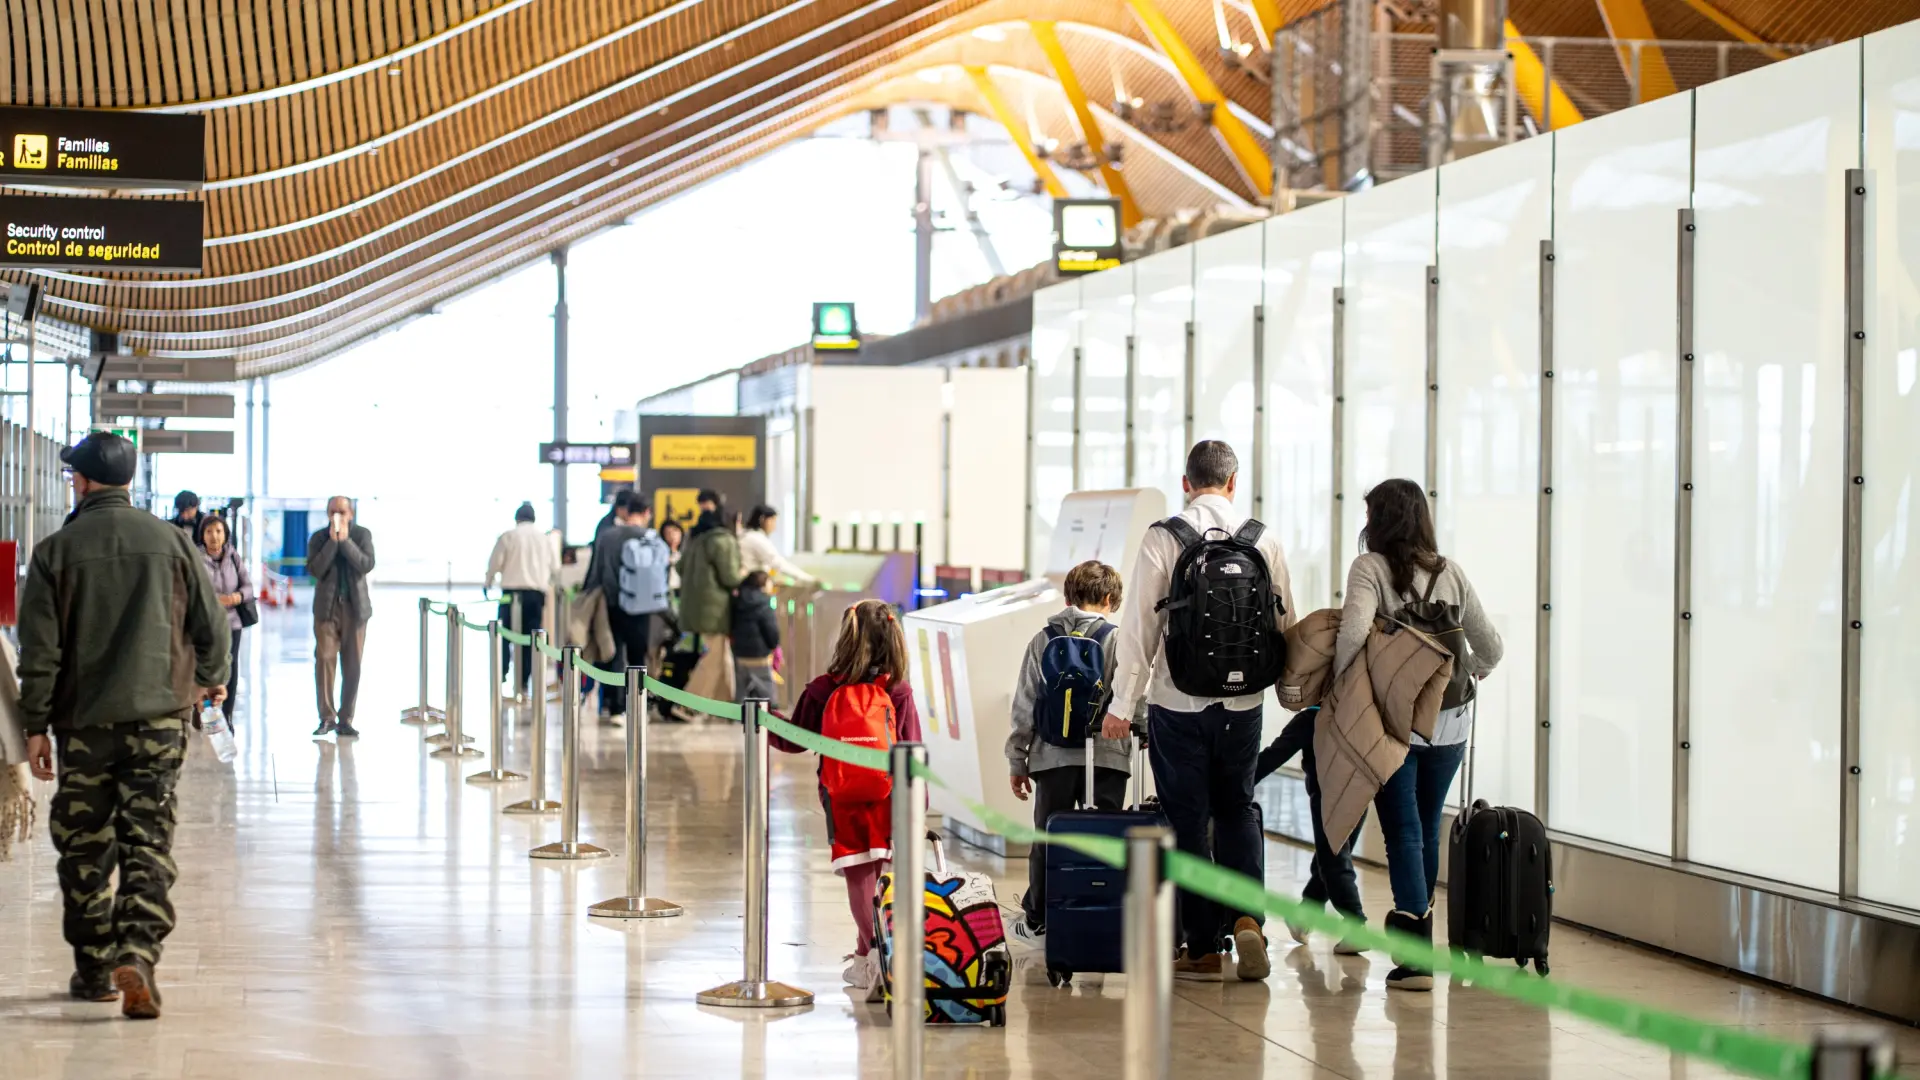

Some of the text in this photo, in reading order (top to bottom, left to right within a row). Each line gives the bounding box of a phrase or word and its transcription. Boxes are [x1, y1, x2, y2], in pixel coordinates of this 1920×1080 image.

[58, 137, 109, 152] Families
[58, 153, 118, 170] Familias
[7, 223, 104, 240] Security control
[7, 239, 159, 260] Control de seguridad
